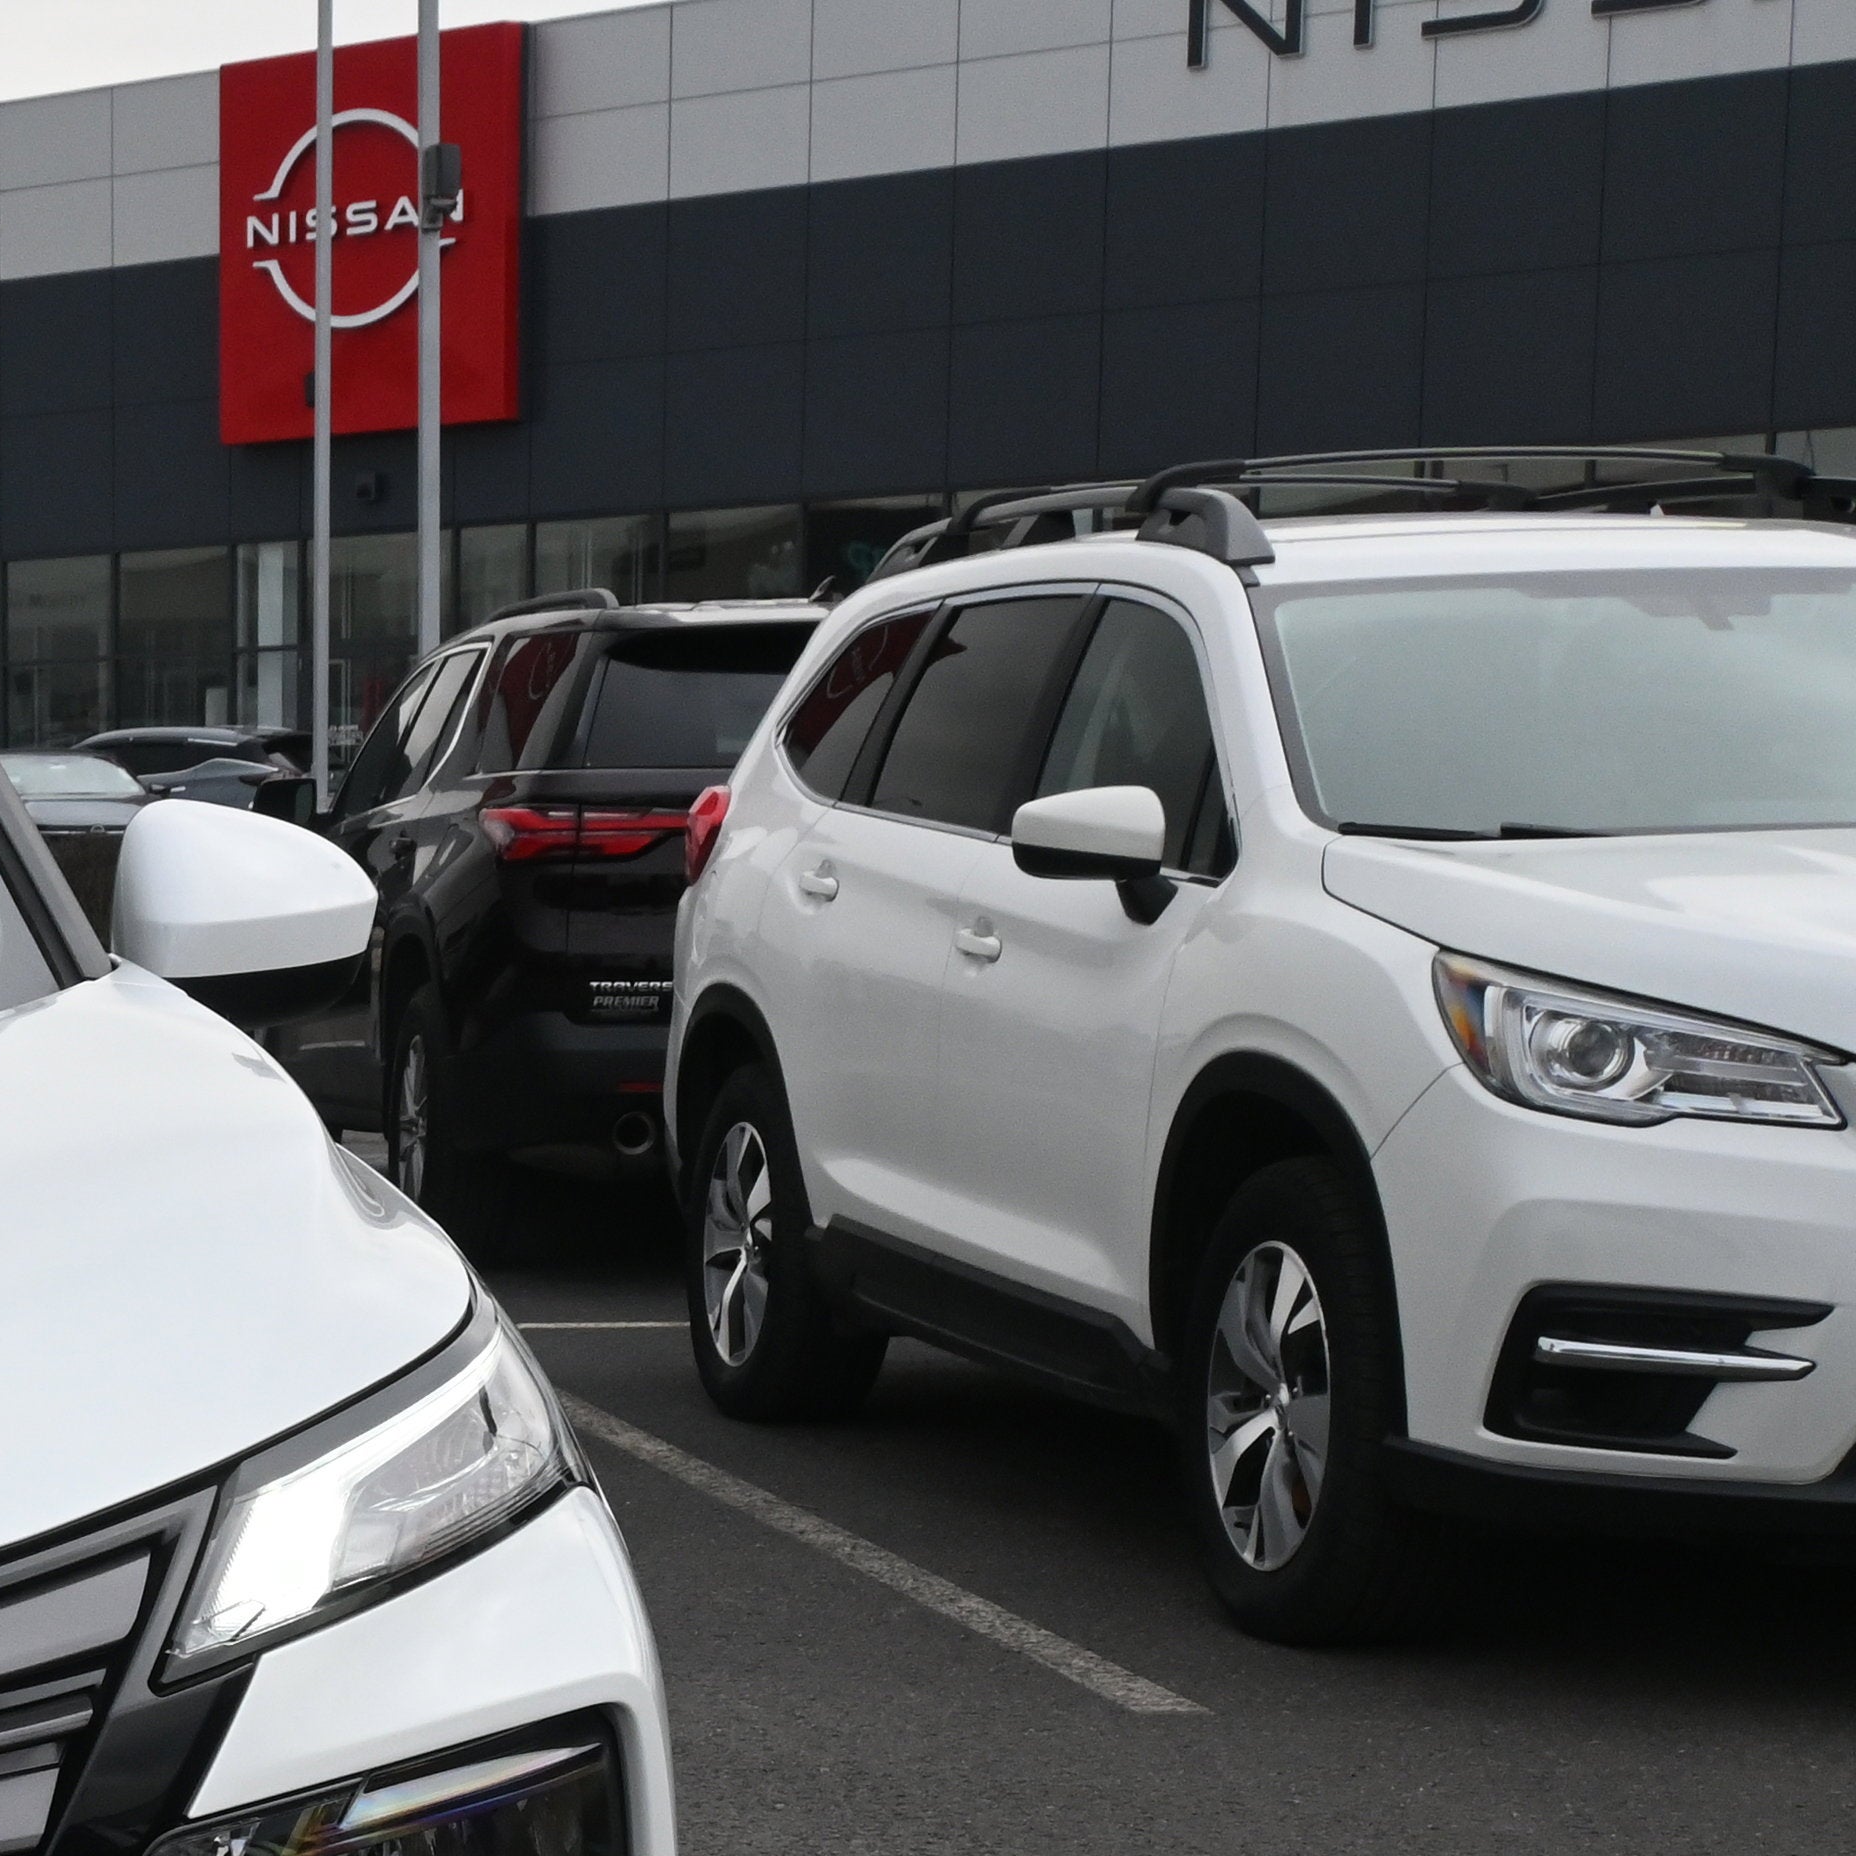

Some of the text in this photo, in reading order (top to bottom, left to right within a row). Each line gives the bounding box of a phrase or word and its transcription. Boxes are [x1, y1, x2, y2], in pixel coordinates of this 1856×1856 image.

[246, 188, 464, 249] NISSA
[589, 981, 673, 992] TRAVERS
[593, 995, 659, 1007] PREMIER
